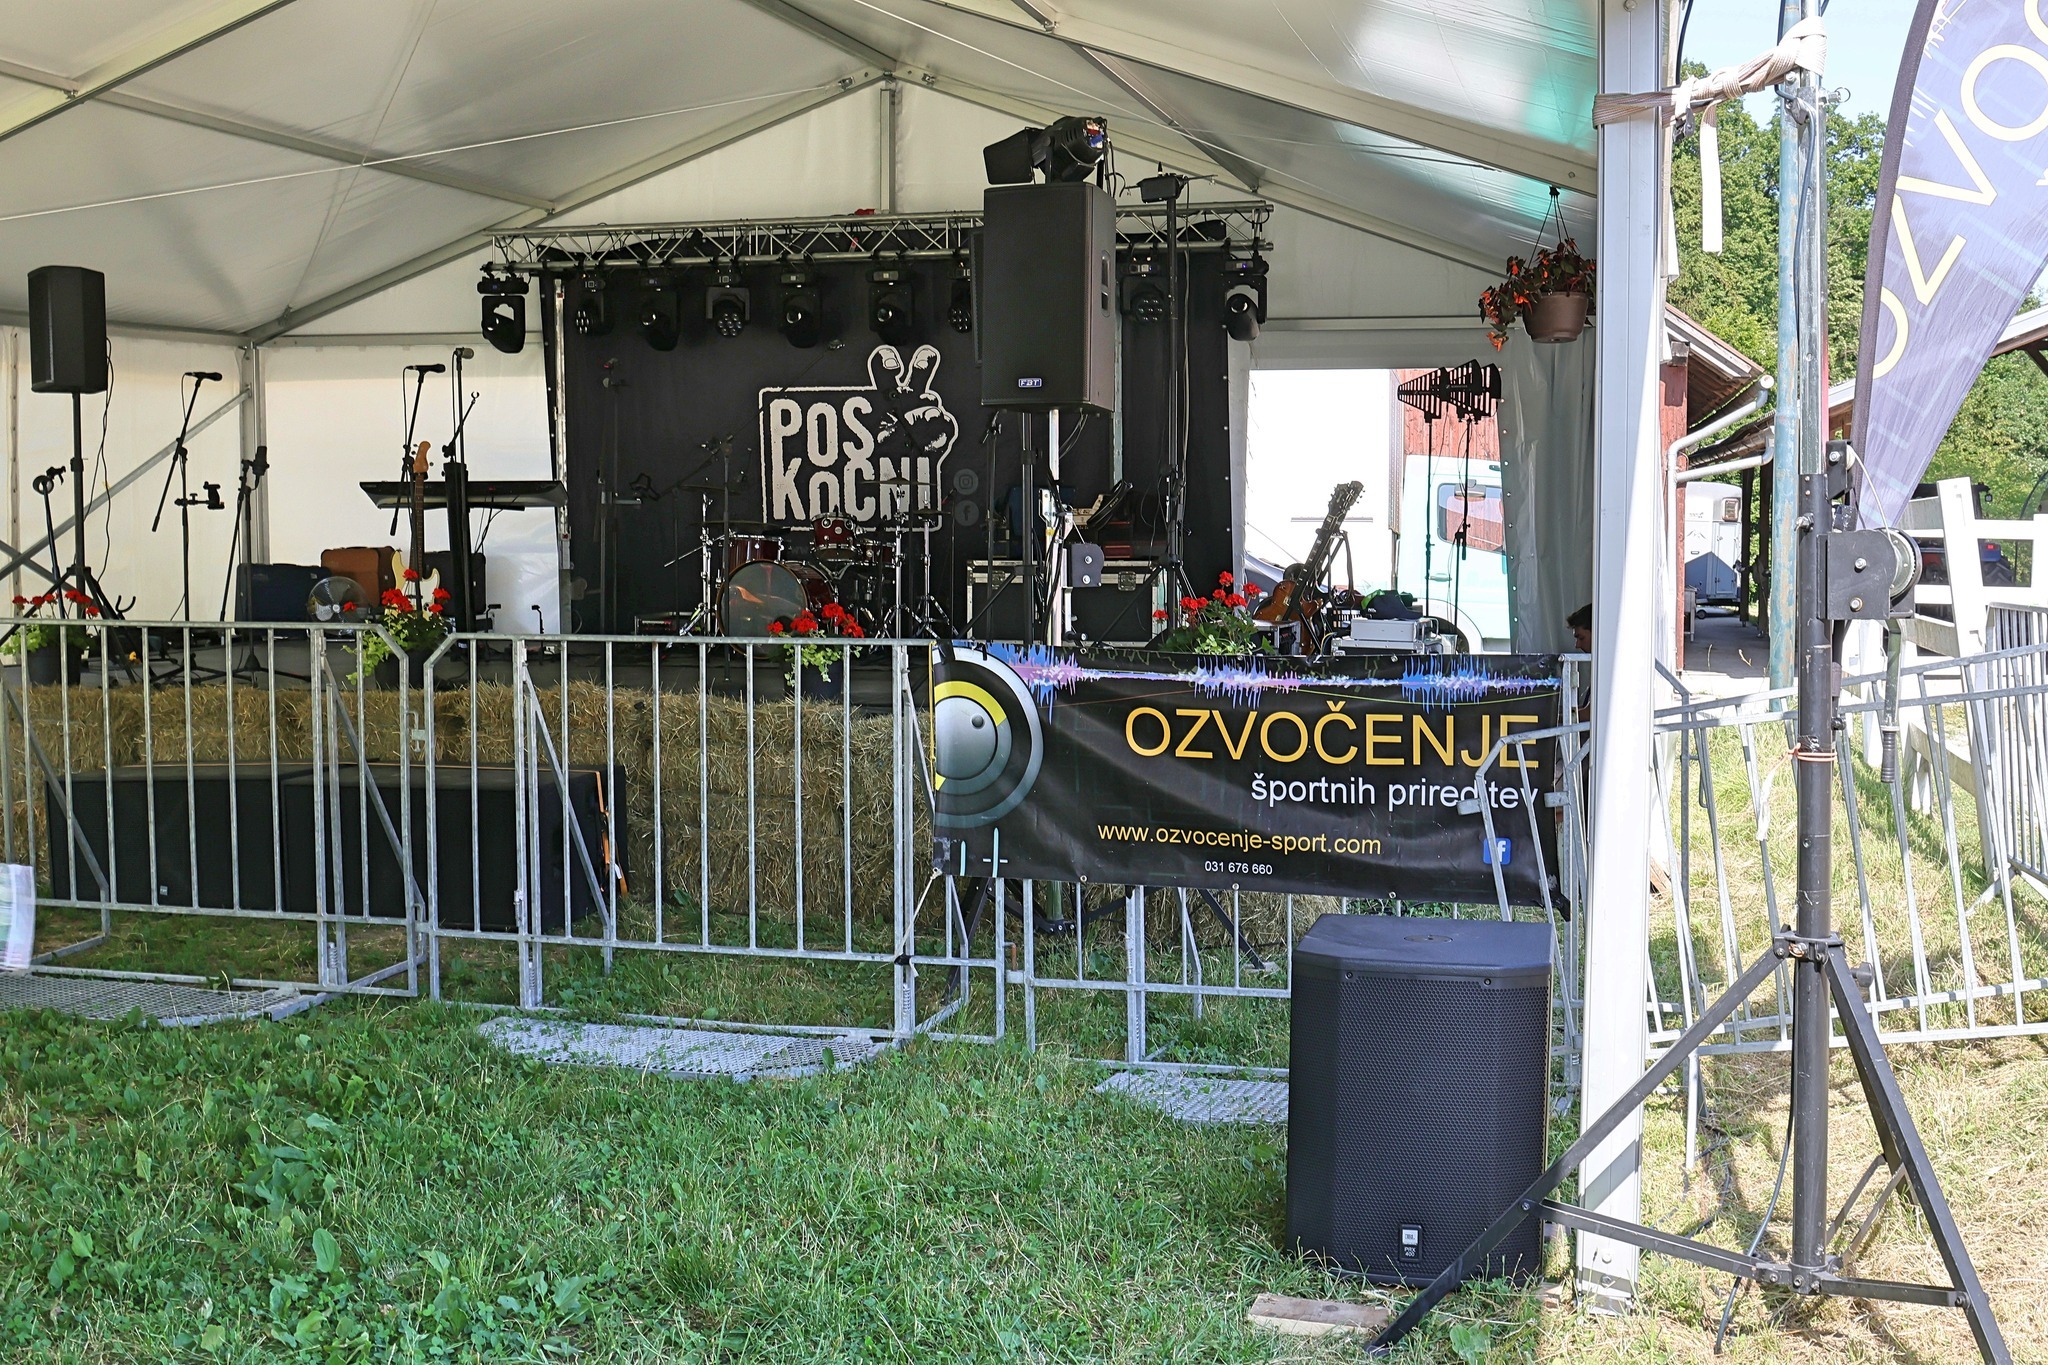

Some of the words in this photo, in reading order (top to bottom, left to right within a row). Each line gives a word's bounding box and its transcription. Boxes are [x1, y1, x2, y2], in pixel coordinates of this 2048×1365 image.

[770, 397, 874, 466] POS
[1126, 701, 1539, 768] OZVOČENJE
[1251, 772, 1376, 808] športnih
[1388, 777, 1539, 812] priredtev
[1098, 824, 1381, 855] www.ozvocenje-sport.com
[1204, 860, 1224, 873] 031
[1228, 862, 1249, 874] 676
[1252, 863, 1273, 875] 660
